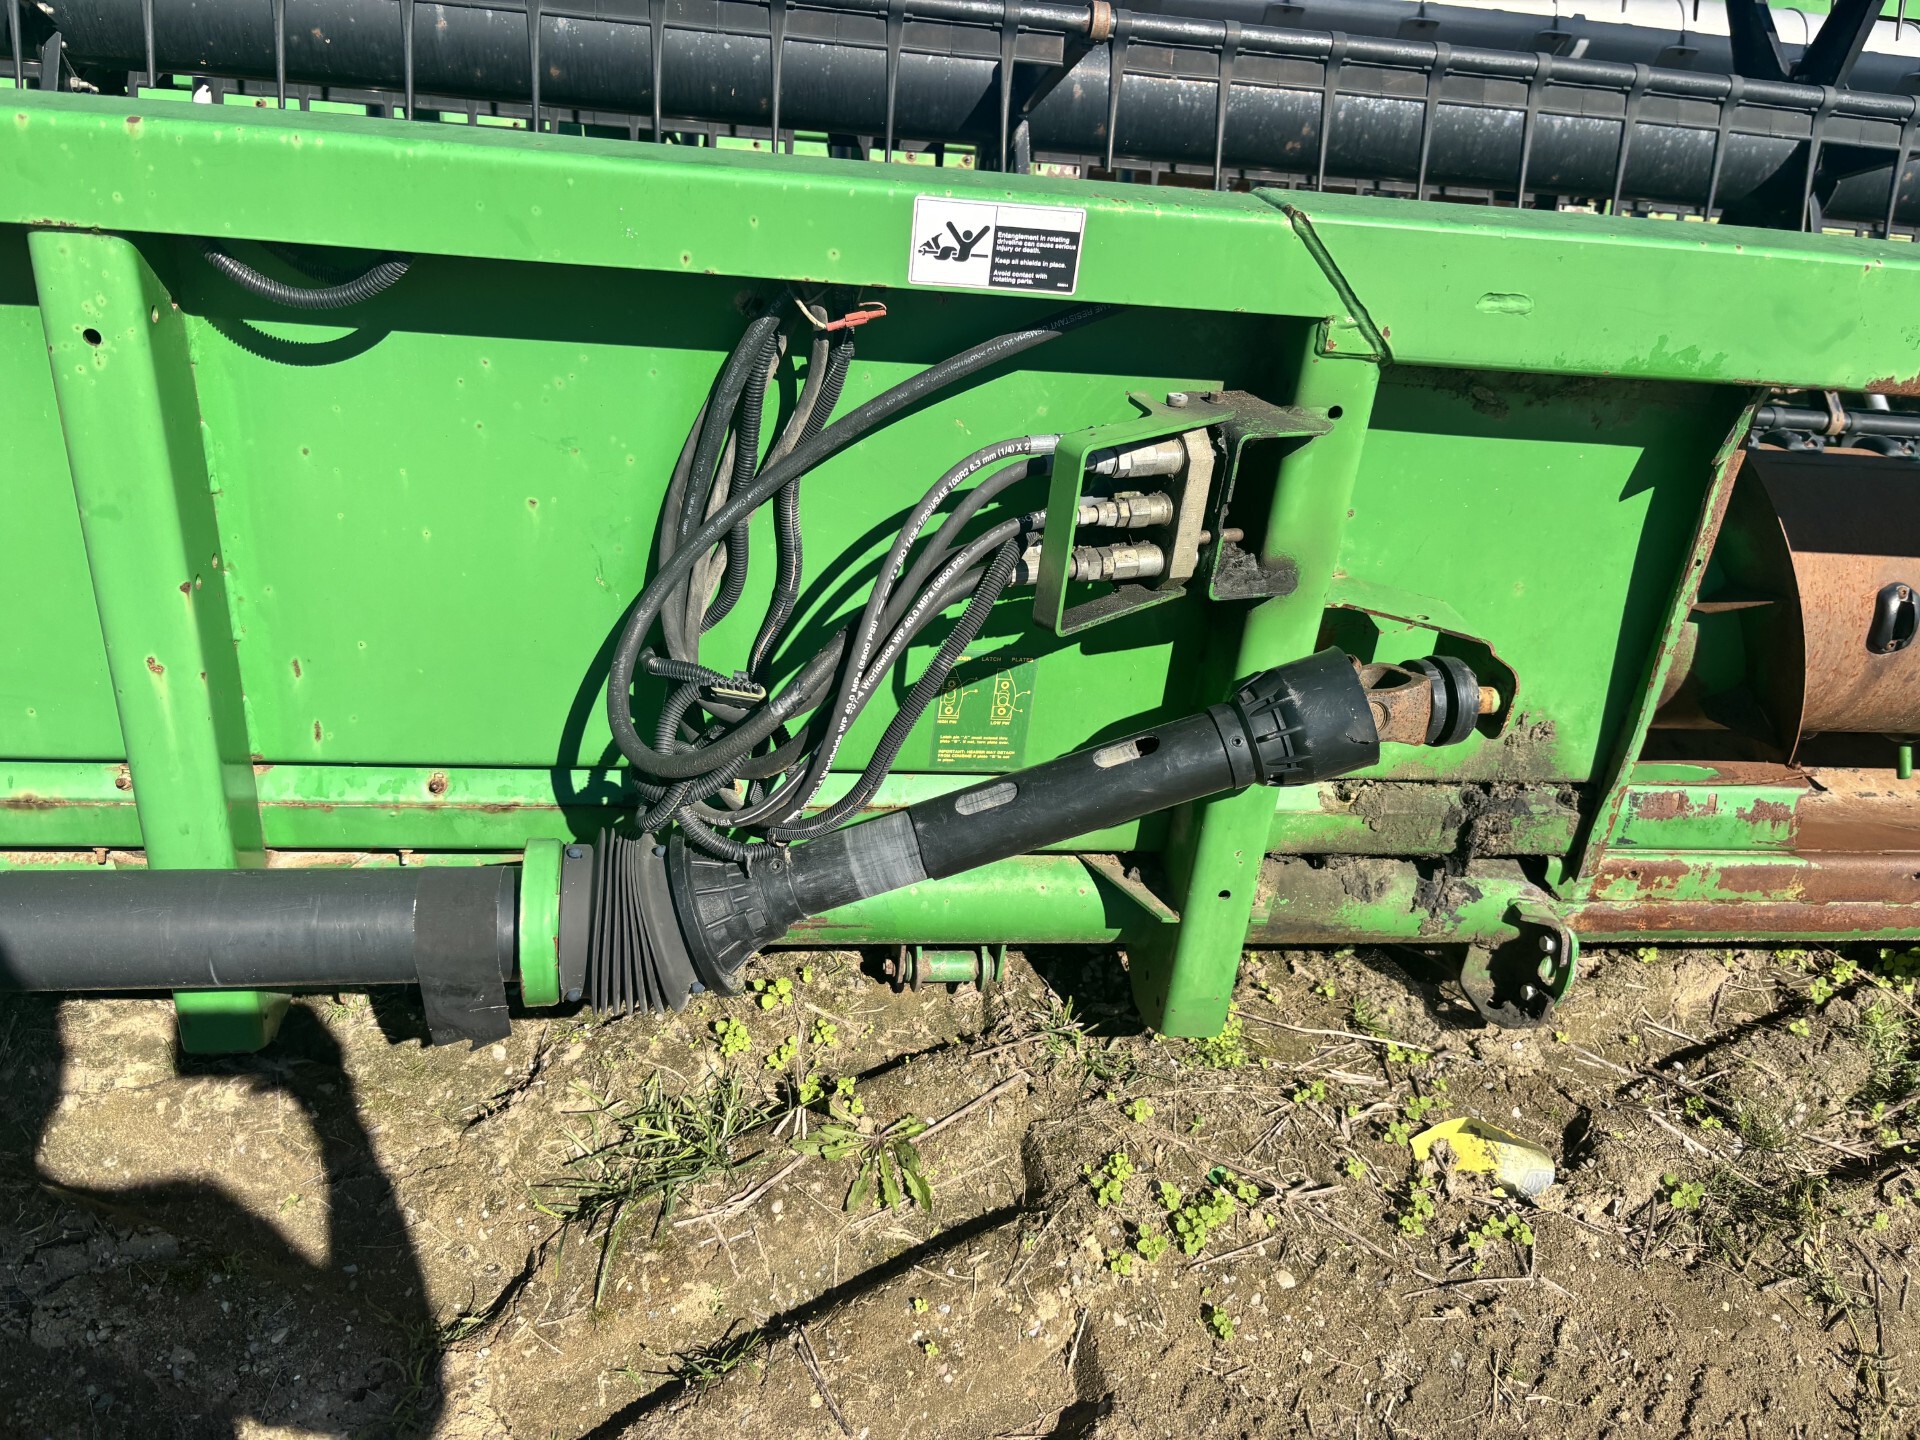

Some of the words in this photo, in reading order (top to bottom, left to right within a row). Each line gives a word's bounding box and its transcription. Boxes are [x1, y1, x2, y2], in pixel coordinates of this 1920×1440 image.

[995, 257, 1010, 265] Keep
[998, 232, 1039, 240] Entanglement
[896, 549, 907, 566] ISO
[948, 469, 970, 489] 100R2
[982, 451, 996, 464] mm
[998, 444, 1015, 457] (1/4)
[1016, 444, 1023, 452] X
[862, 644, 895, 690] Worldwide
[892, 628, 905, 644] WP
[917, 591, 934, 610] MPa
[932, 568, 953, 592] (5800
[820, 734, 843, 778] Worldwide
[839, 716, 848, 736] WP
[851, 672, 862, 692] MPa
[858, 642, 871, 670] (5800
[867, 620, 878, 641] PSI)
